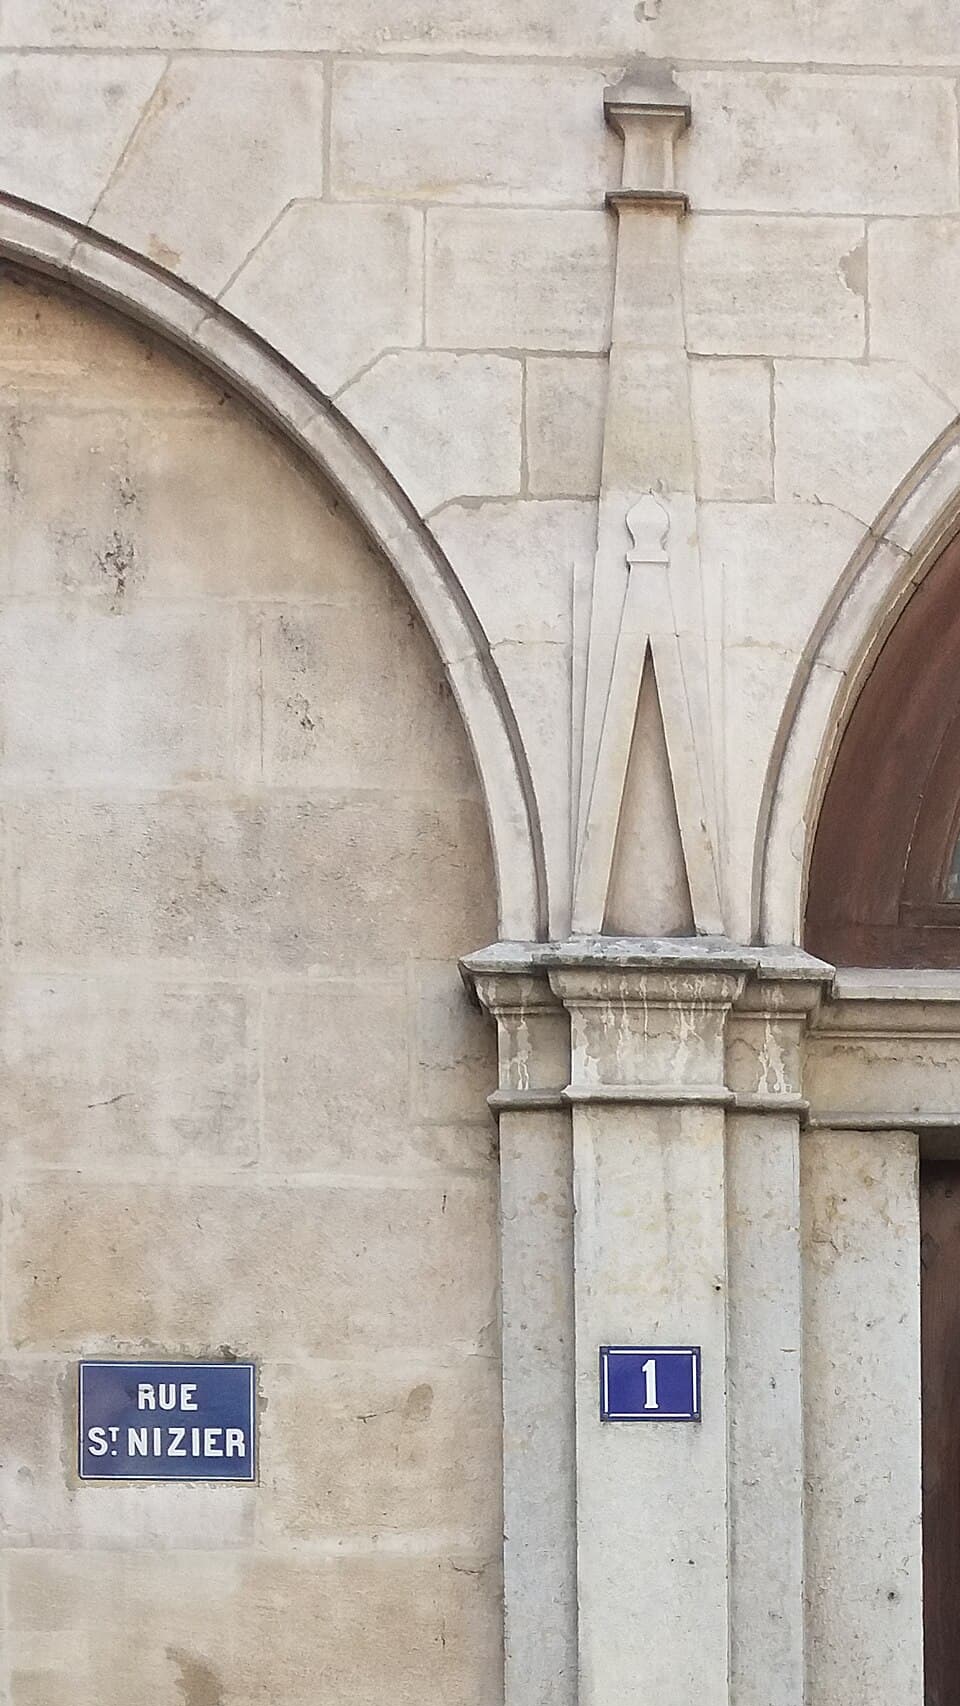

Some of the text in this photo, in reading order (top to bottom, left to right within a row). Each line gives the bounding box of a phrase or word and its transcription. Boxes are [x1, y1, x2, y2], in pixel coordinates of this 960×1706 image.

[138, 1383, 198, 1411] RUE
[642, 1359, 659, 1409] 1
[127, 1427, 246, 1457] NIZIER
